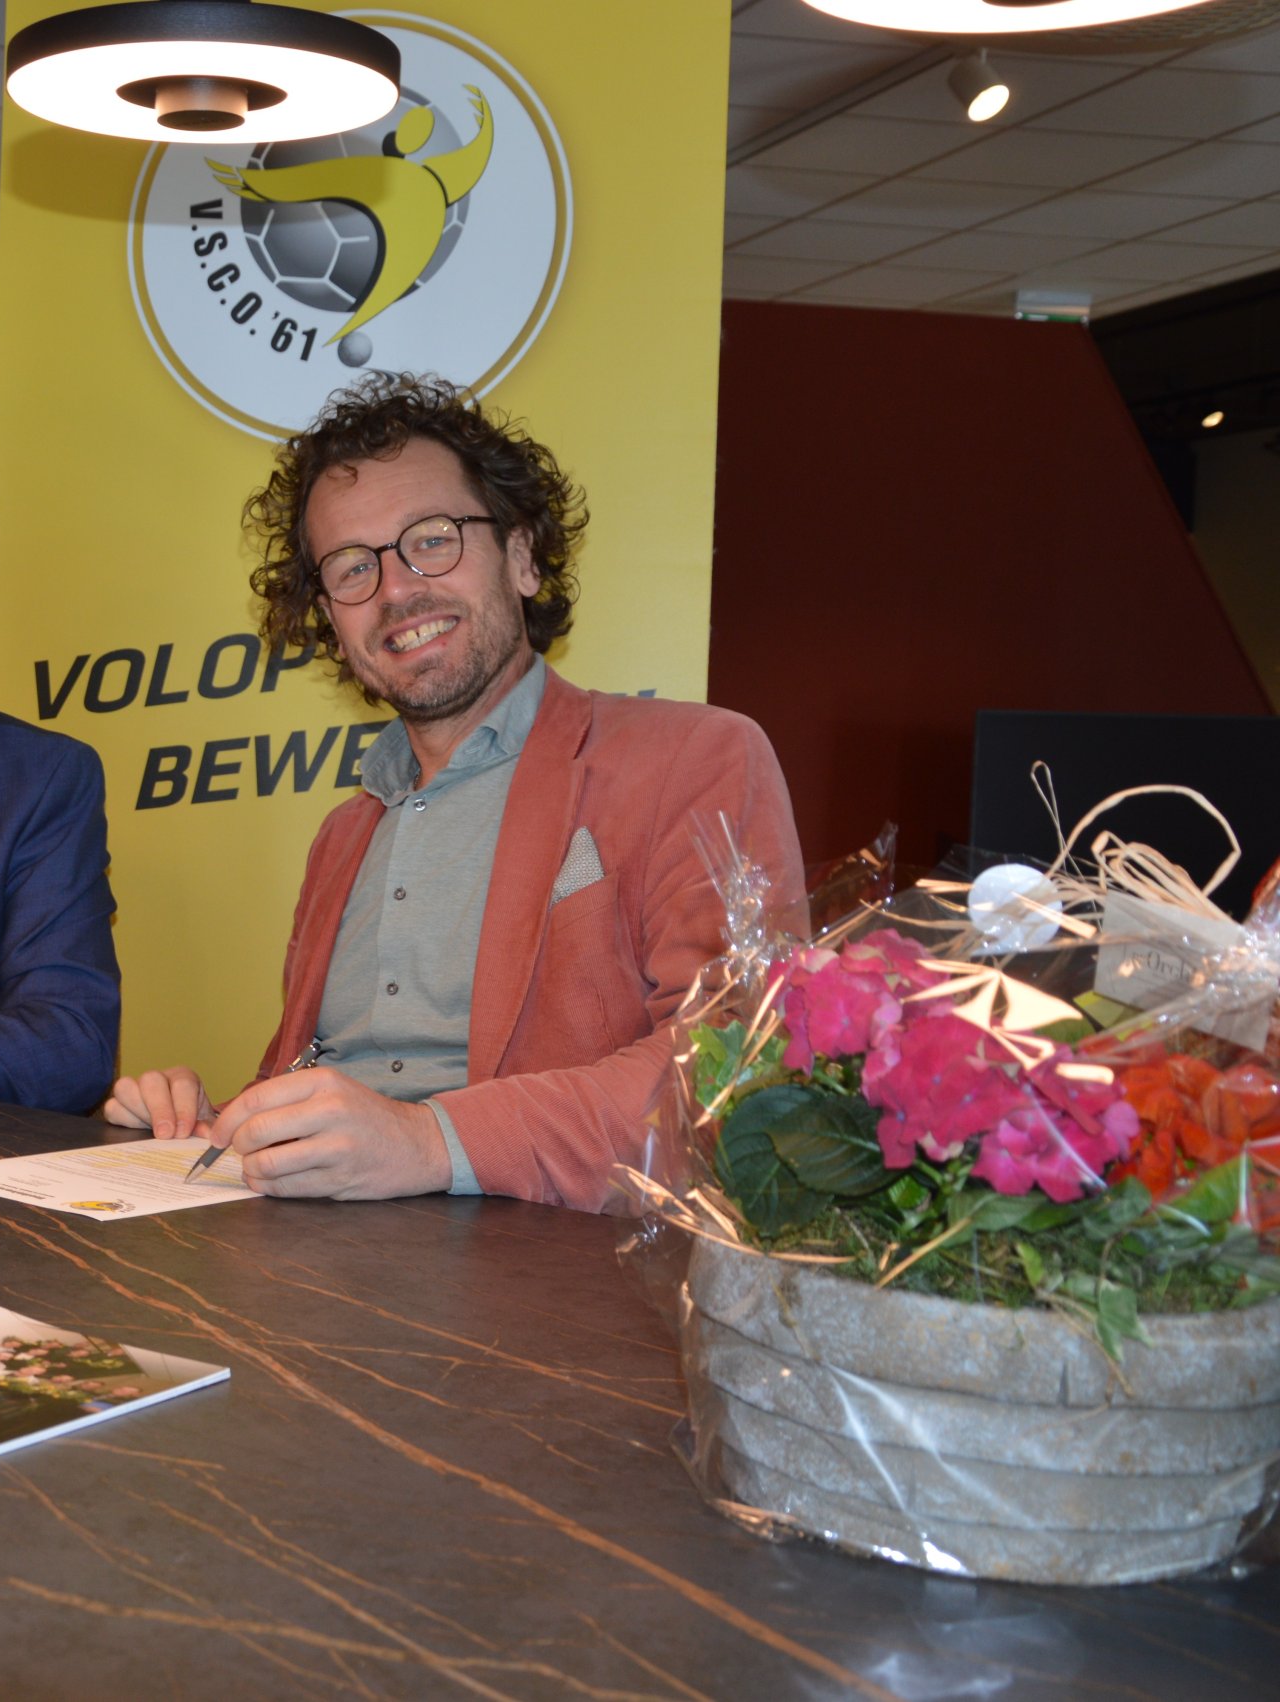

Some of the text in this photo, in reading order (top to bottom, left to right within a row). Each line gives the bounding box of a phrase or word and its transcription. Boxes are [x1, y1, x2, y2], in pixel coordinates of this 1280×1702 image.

[189, 197, 263, 336] V.S.C.O.
[34, 626, 318, 720] VOLOP
[134, 720, 394, 811] BEWE
